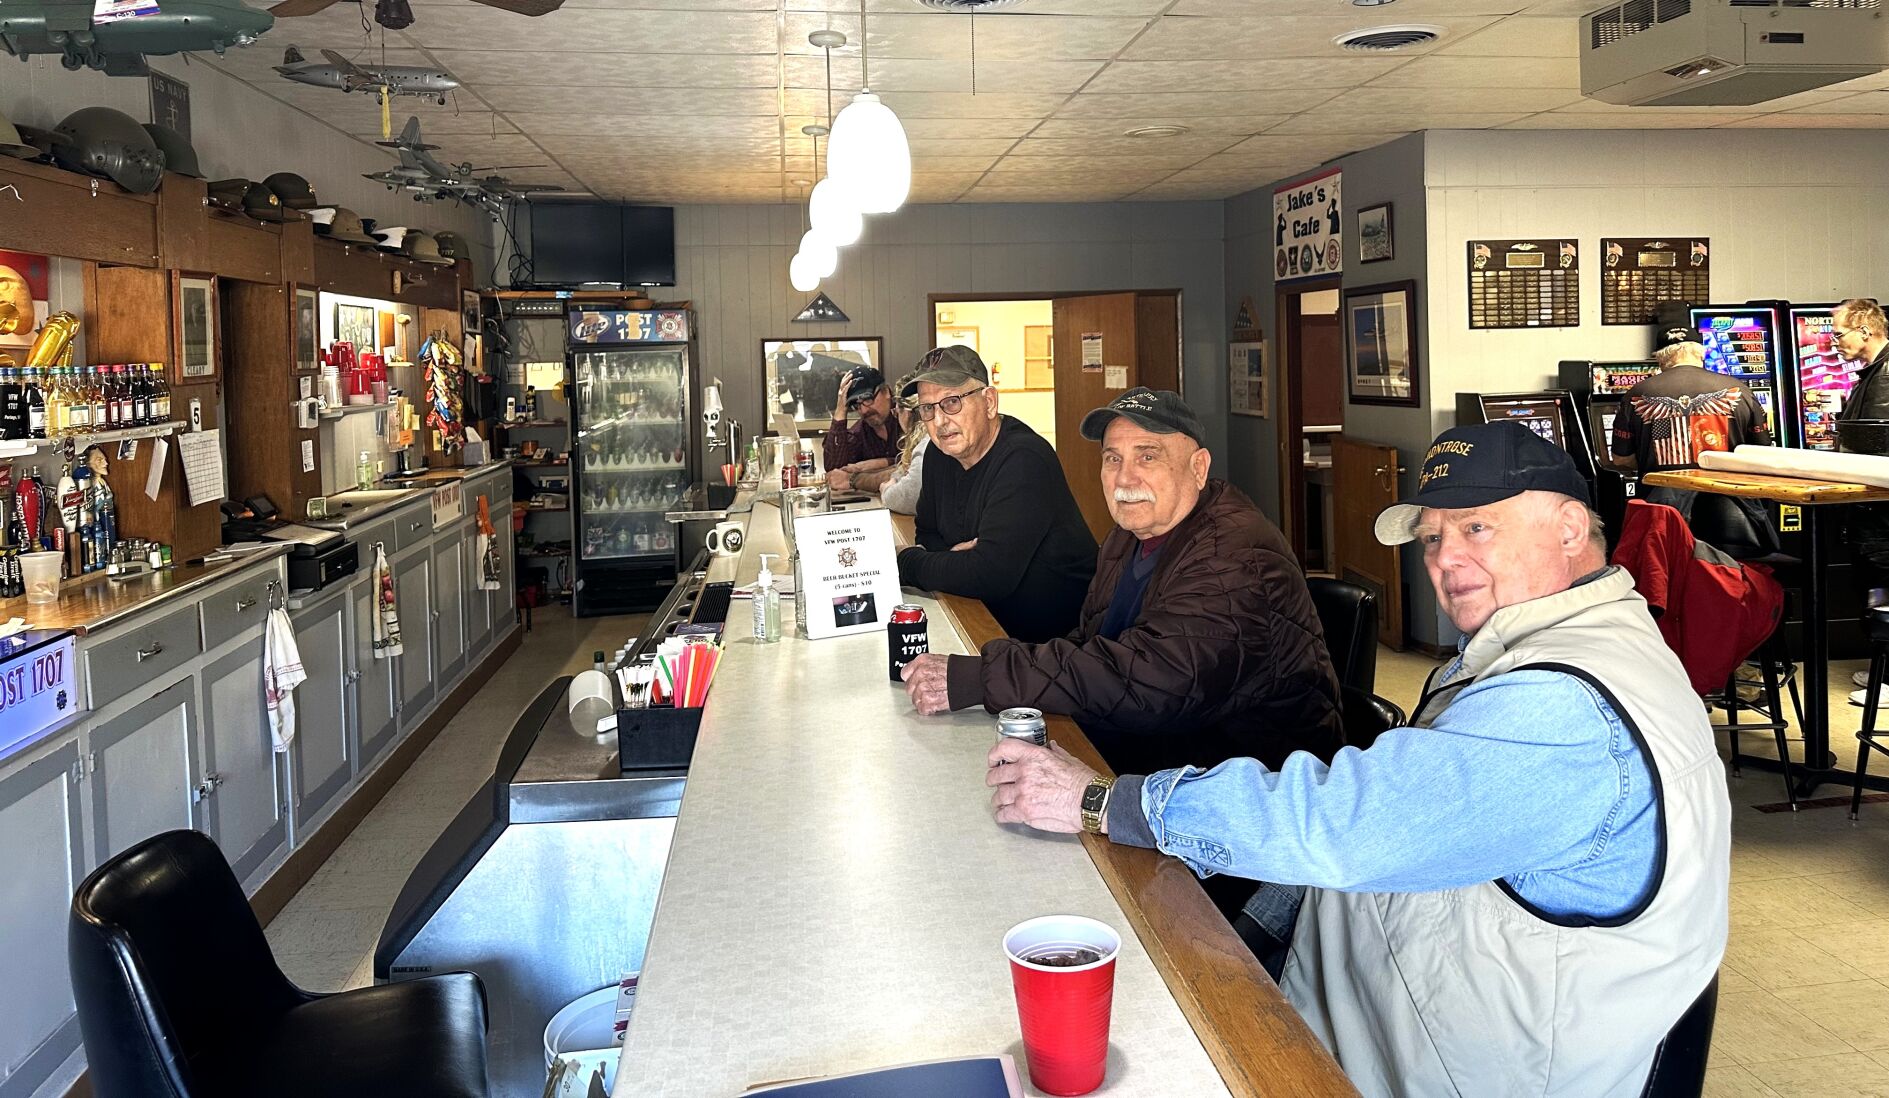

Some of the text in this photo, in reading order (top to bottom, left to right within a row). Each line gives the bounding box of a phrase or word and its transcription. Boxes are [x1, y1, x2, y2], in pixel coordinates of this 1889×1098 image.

[153, 76, 187, 101] US NAVY
[1287, 185, 1326, 212] Jake's
[1293, 216, 1320, 238] Cafe
[193, 407, 200, 425] 5
[1426, 440, 1474, 459] MONTROSE
[1628, 484, 1634, 496] 2
[902, 632, 927, 643] VFW
[901, 644, 928, 655] 1707
[30, 647, 65, 697] 1707
